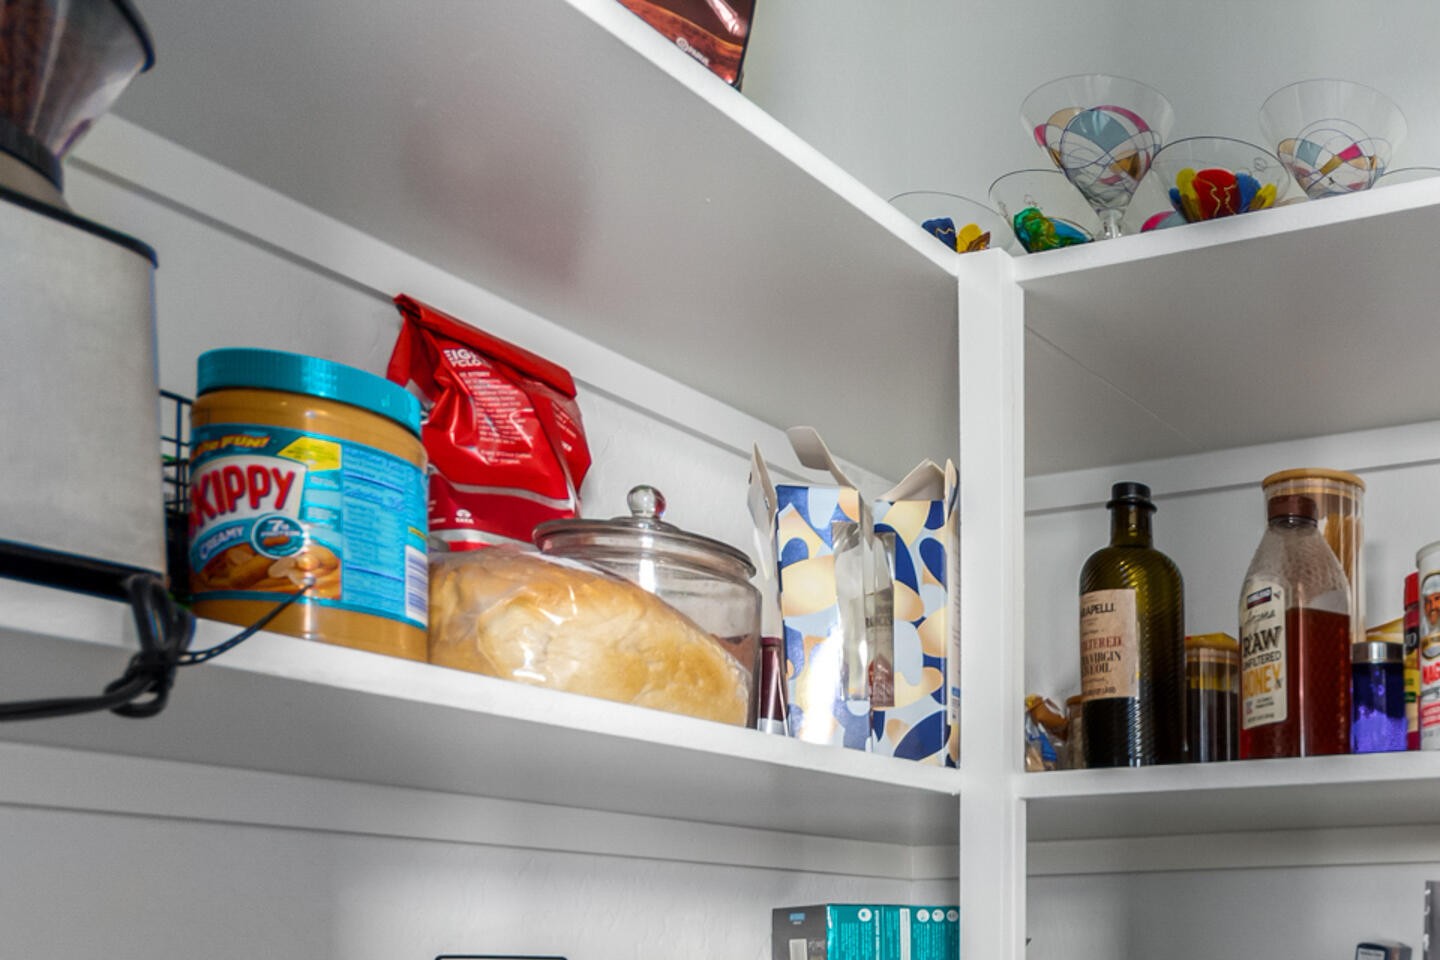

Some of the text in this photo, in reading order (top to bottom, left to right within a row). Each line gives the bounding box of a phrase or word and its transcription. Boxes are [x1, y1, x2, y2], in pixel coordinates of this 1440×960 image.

[200, 525, 244, 560] CREAMY
[1243, 625, 1282, 660] RAW
[1242, 662, 1282, 700] HONEY
